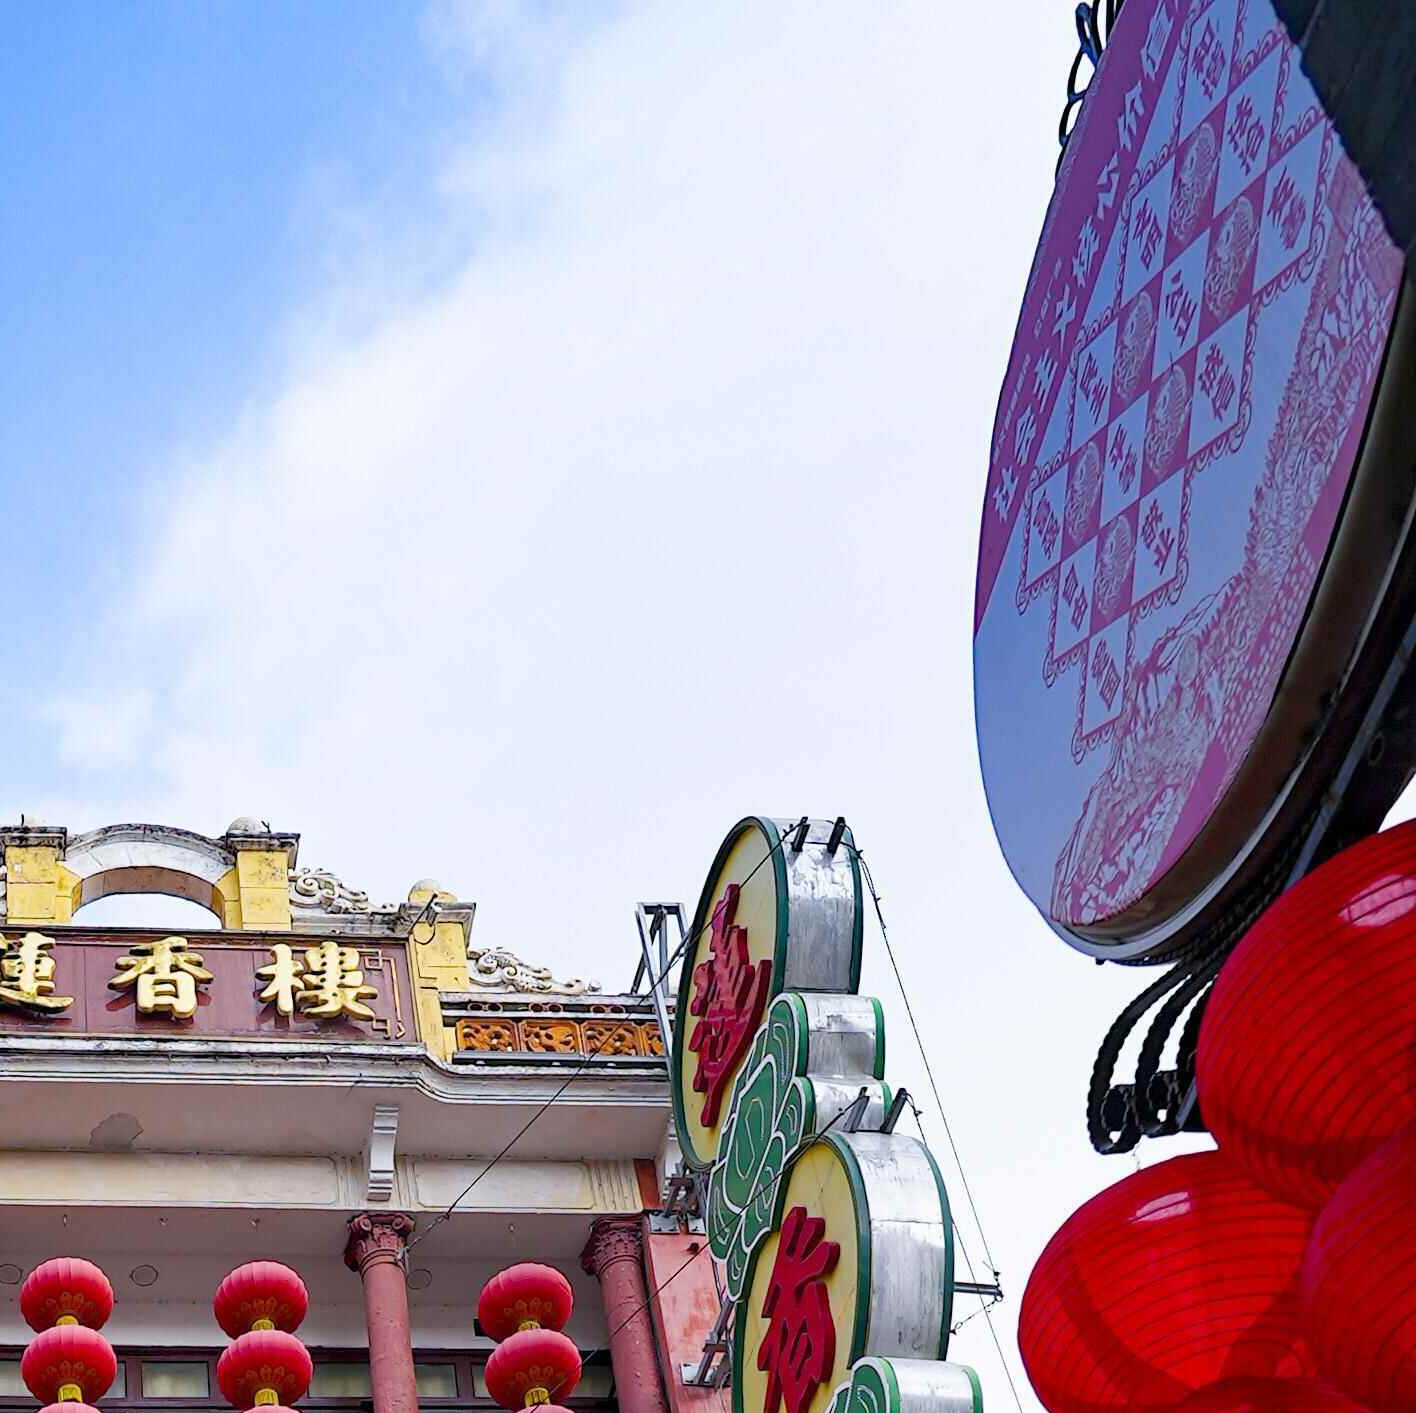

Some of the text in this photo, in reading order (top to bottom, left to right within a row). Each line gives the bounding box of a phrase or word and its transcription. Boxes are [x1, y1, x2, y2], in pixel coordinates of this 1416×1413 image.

[1227, 95, 1265, 176] 法治
[993, 0, 1178, 522] 社会主义核心价值
[1132, 200, 1164, 272] 文明
[1165, 269, 1198, 348] 公正
[1080, 352, 1109, 424] 民主
[1197, 342, 1236, 423] 诚信
[1062, 564, 1088, 631] 自由
